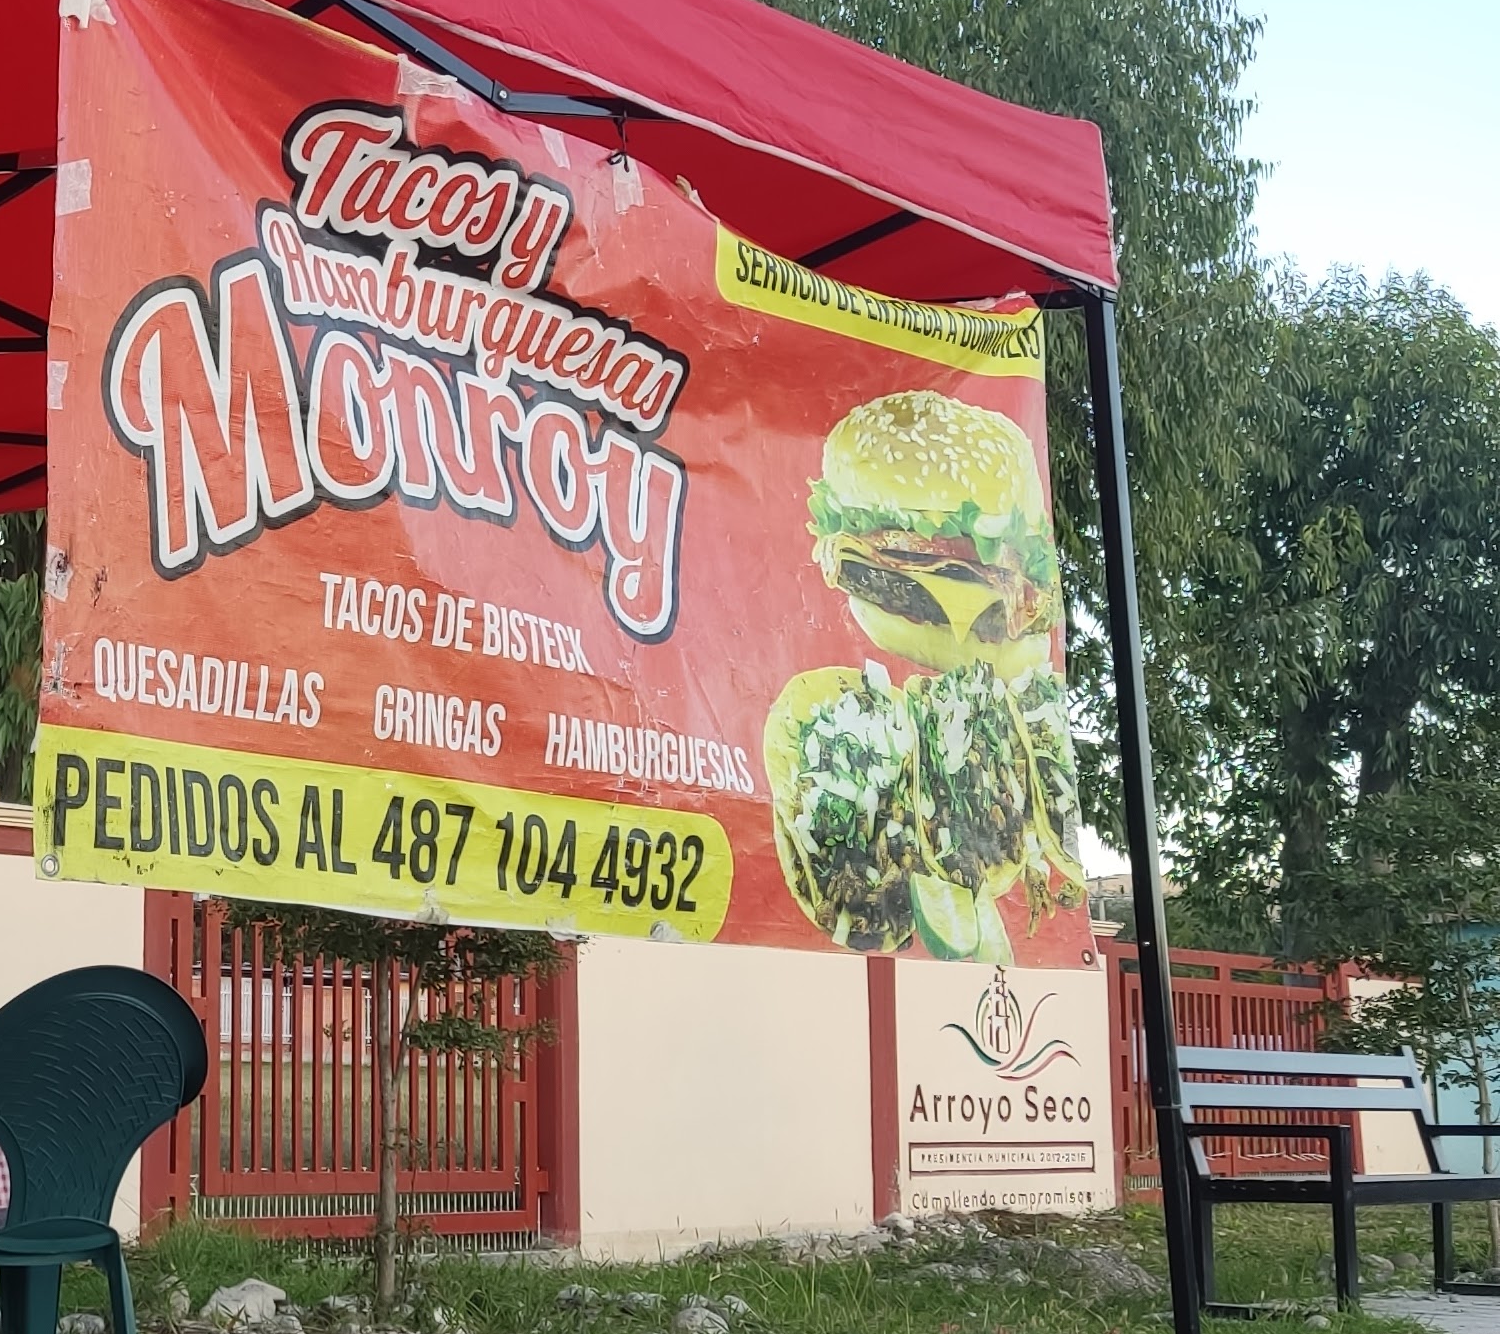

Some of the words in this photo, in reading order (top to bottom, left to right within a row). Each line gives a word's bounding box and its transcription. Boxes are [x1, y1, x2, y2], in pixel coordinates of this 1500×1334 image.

[294, 113, 515, 251] Tacos
[495, 187, 567, 289] y
[263, 210, 682, 429] Hamburguesas
[736, 240, 830, 307] SERVICIO
[831, 279, 862, 316] DE
[857, 286, 943, 341] ENTREGA
[944, 308, 958, 345] A
[957, 311, 1041, 360] DOMICILIO
[110, 260, 683, 636] Monroy
[319, 571, 427, 644] TACOS
[431, 592, 476, 652] DE
[481, 602, 595, 676] BISTECK
[93, 636, 325, 729] QUESADILLAS
[373, 684, 507, 757] GRINGAS
[544, 712, 755, 795] HAMBURGUESAS
[53, 752, 280, 867] PEDIDOS
[295, 784, 358, 875] AL
[372, 795, 476, 885] 487
[495, 811, 577, 899] 104
[590, 825, 705, 912] 4932
[909, 1083, 1012, 1135] Arroyo
[1025, 1085, 1092, 1123] Seco
[987, 1152, 1036, 1163] MUNICIPAL
